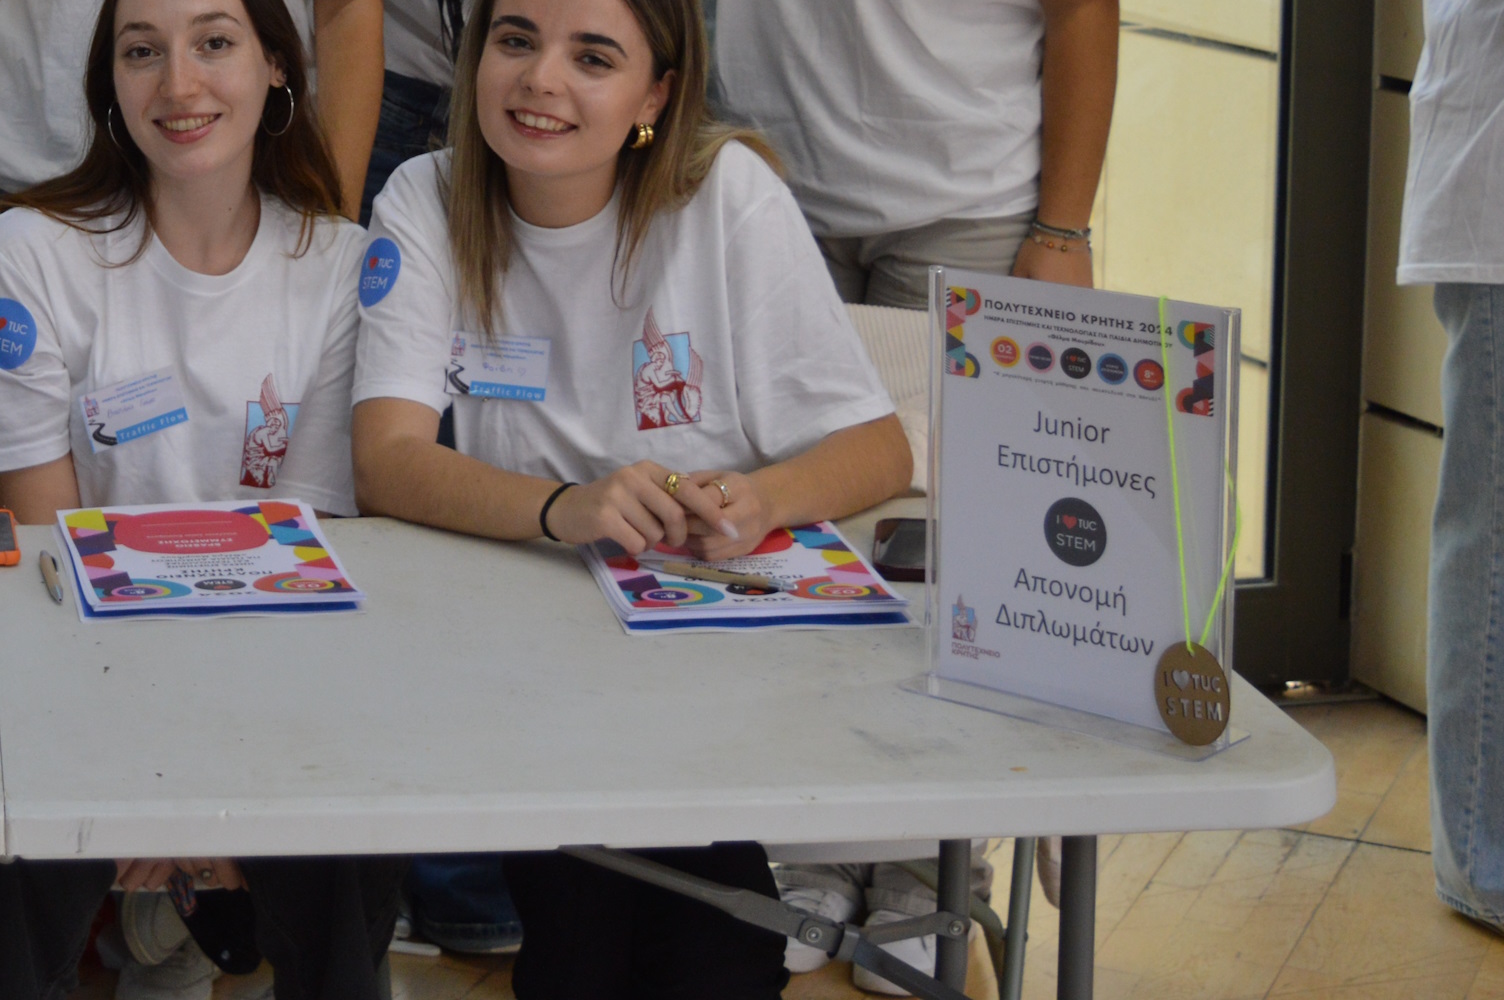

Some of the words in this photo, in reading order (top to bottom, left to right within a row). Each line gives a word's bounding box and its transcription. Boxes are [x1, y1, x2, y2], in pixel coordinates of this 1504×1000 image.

[378, 257, 394, 269] TUC
[362, 276, 388, 289] STEM
[984, 299, 1076, 321] ΠΟΛΥΤΕΧΝΕΙΟ
[1081, 314, 1134, 331] ΚΡΗΤΗΣ
[8, 320, 29, 335] TUC
[998, 343, 1013, 354] 02
[1068, 365, 1085, 373] STEM
[473, 385, 510, 396] Traffic
[516, 389, 542, 399] Flow
[120, 421, 156, 440] Traffic
[159, 413, 185, 426] Flow
[1033, 410, 1110, 444] Junior
[998, 444, 1156, 499] Επιστήμονες
[1078, 518, 1097, 531] TUC
[1056, 533, 1096, 551] STEM
[1014, 568, 1127, 616] Απονομή
[995, 604, 1154, 656] Διπλωμάτων
[951, 642, 1000, 659] ΠΟΛΥΤΕΧΝΕΙΟ
[951, 649, 979, 660] ΚΡΗΤΗΣ
[1191, 674, 1221, 693] TUC
[1166, 697, 1223, 721] STEM
